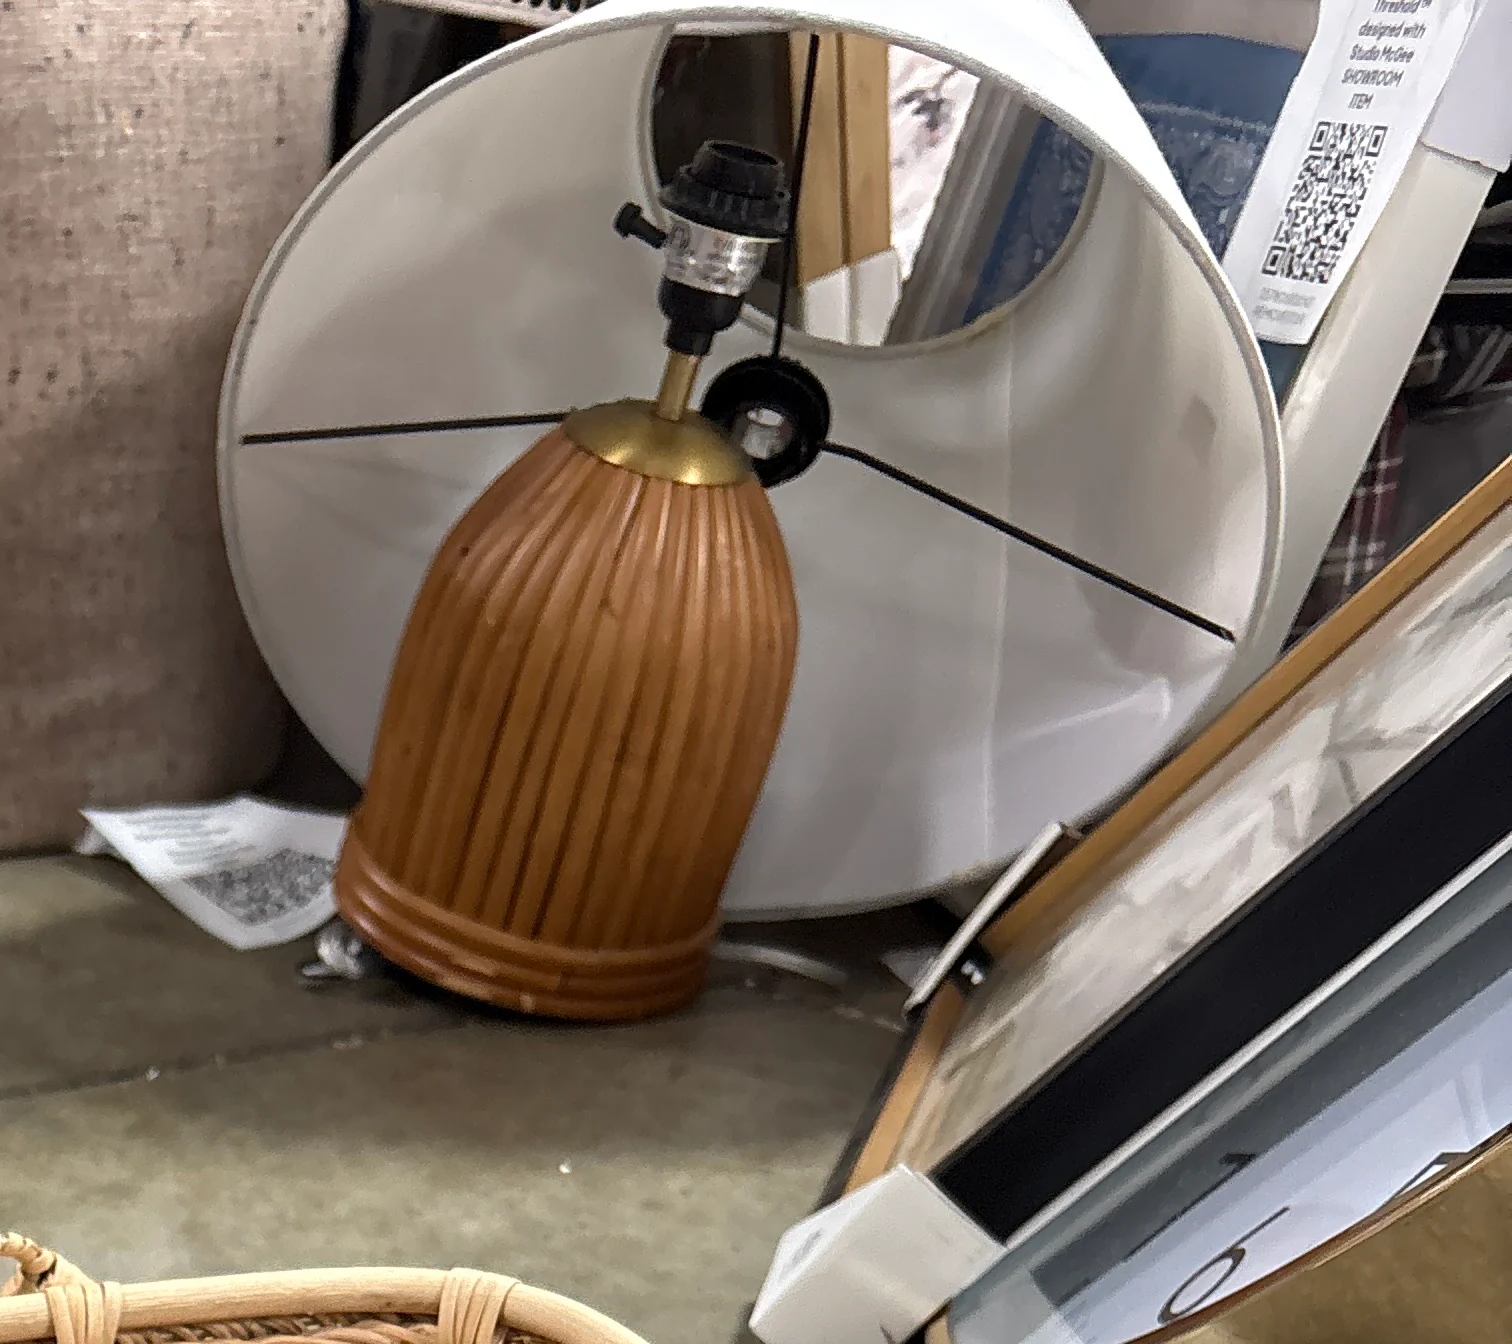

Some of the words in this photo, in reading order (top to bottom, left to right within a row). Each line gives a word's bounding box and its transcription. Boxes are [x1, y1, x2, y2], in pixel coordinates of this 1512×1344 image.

[1358, 18, 1405, 41] designed
[1402, 22, 1426, 39] with
[1350, 43, 1380, 61] Studio
[1379, 44, 1415, 63] McGee
[1341, 68, 1404, 87] SHOWROOM
[1348, 93, 1374, 109] ITEM
